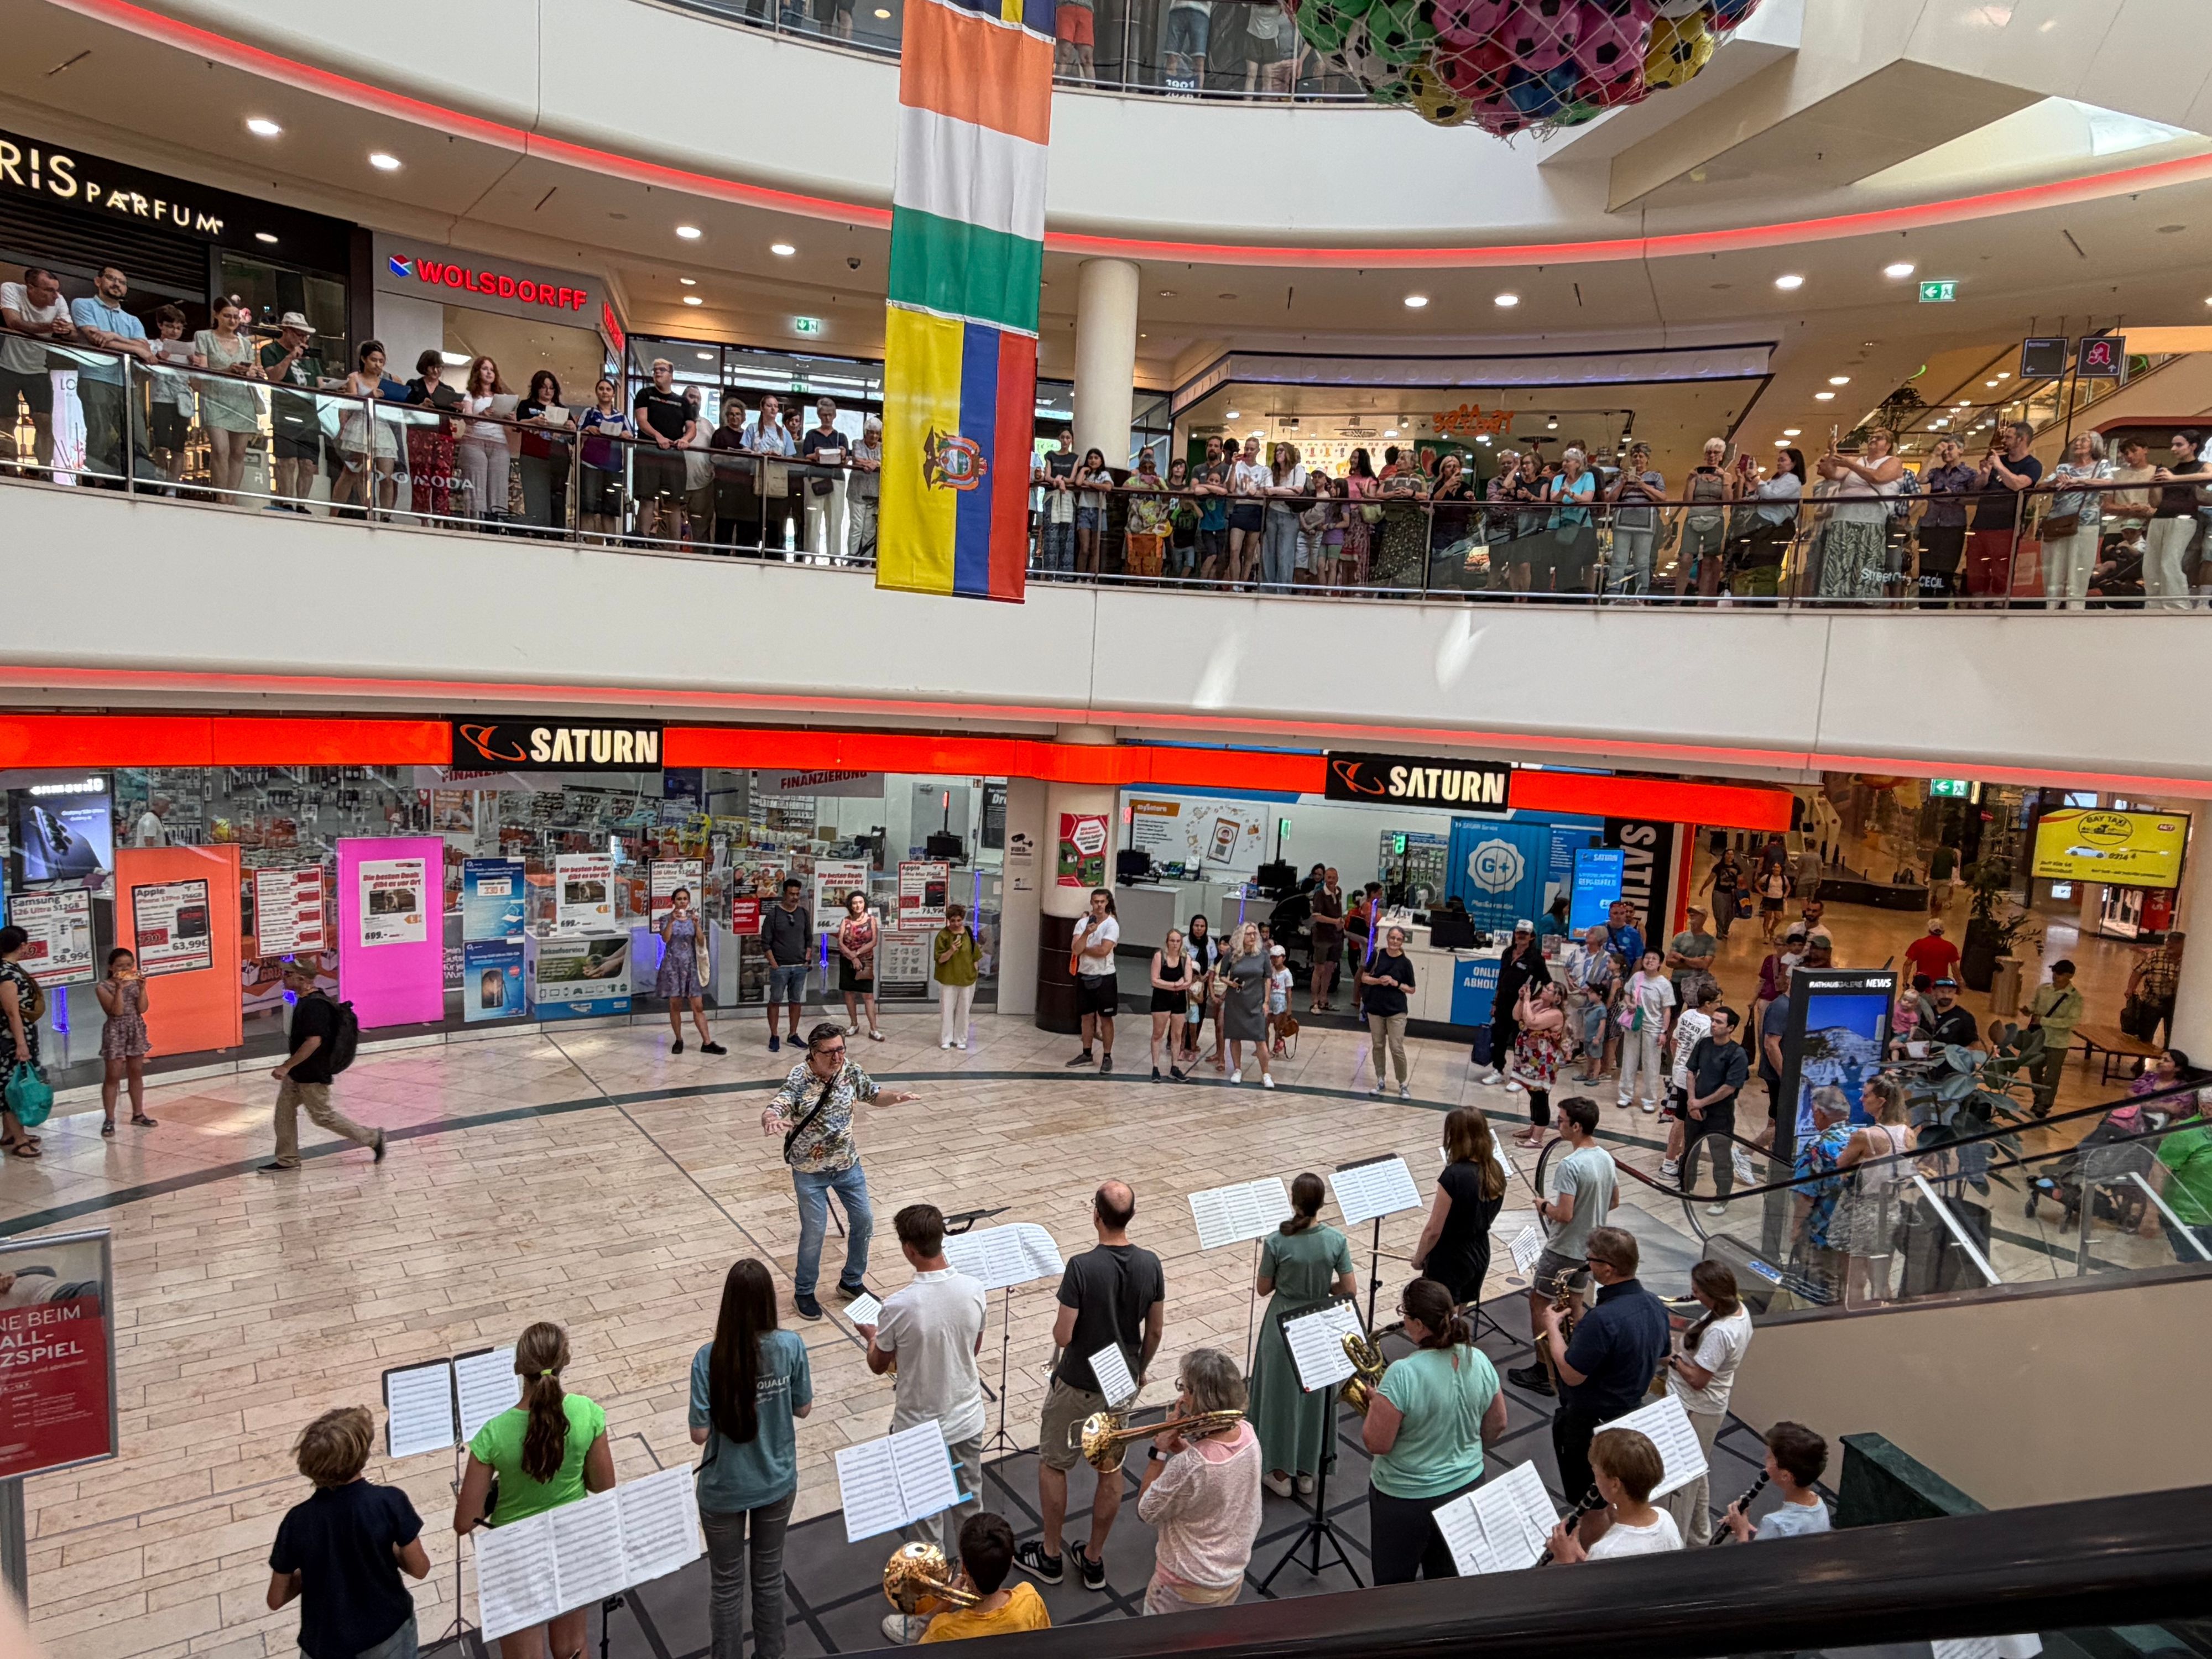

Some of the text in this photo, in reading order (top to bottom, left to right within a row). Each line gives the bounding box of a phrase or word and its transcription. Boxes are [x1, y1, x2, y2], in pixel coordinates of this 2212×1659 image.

[85, 181, 223, 236] PARFUM
[416, 258, 587, 311] WOLSDORFF
[60, 379, 76, 390] LO
[530, 727, 659, 763] SATURN
[1389, 765, 1505, 804] SATURN
[1619, 824, 1657, 925] SATU
[12, 896, 61, 907] Samsung
[136, 888, 166, 897] Apple
[52, 951, 91, 964] 58,99€
[1865, 978, 1892, 988] NEWS
[28, 1305, 81, 1327] BEIM
[0, 1340, 84, 1368] ZSPIEL
